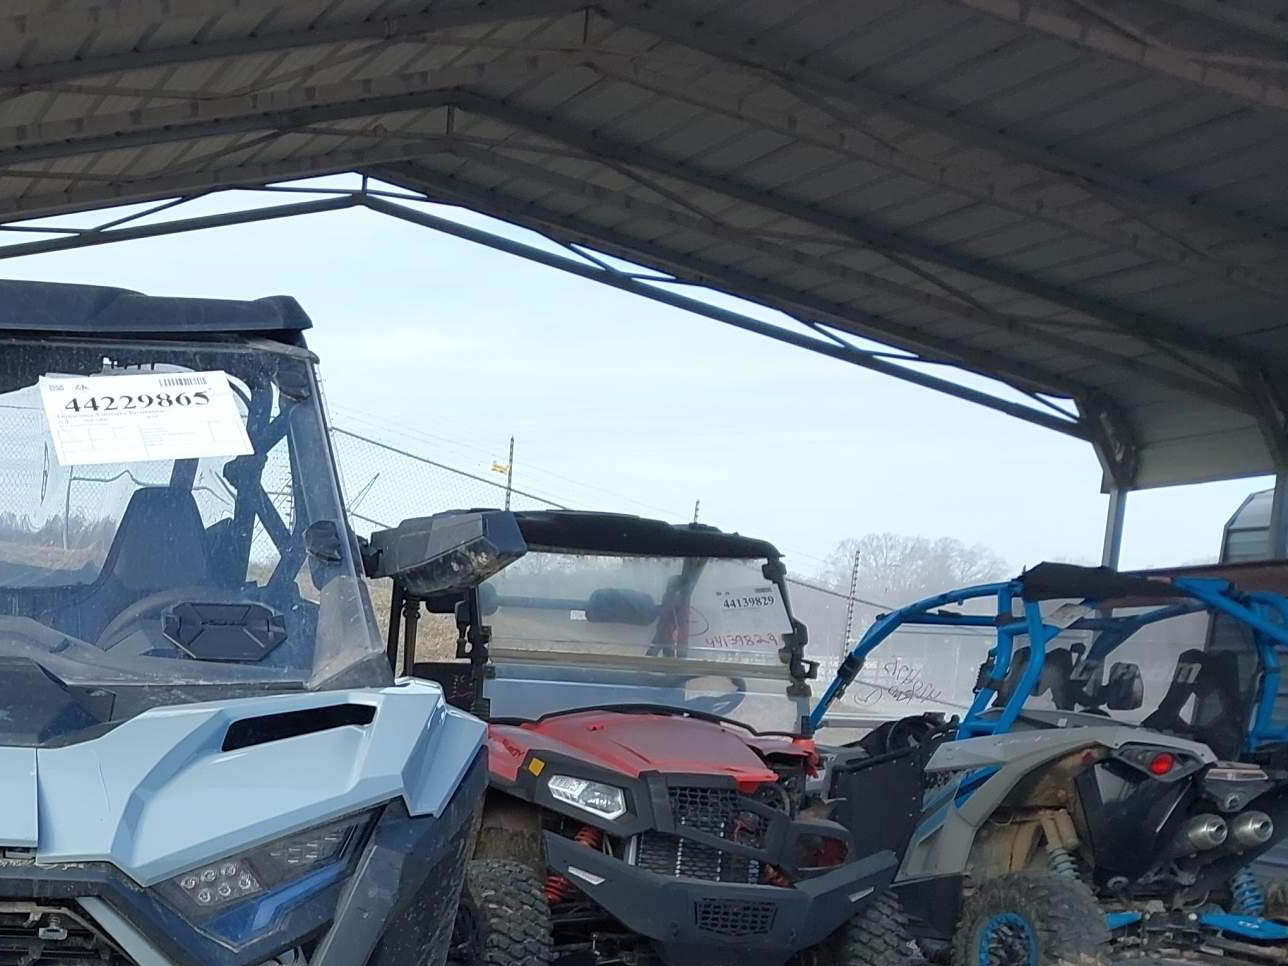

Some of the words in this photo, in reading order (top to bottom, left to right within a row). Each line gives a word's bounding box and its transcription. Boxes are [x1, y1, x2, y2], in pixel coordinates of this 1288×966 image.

[65, 391, 211, 412] 44229865
[723, 595, 774, 609] 44139829
[705, 632, 778, 648] 44139829
